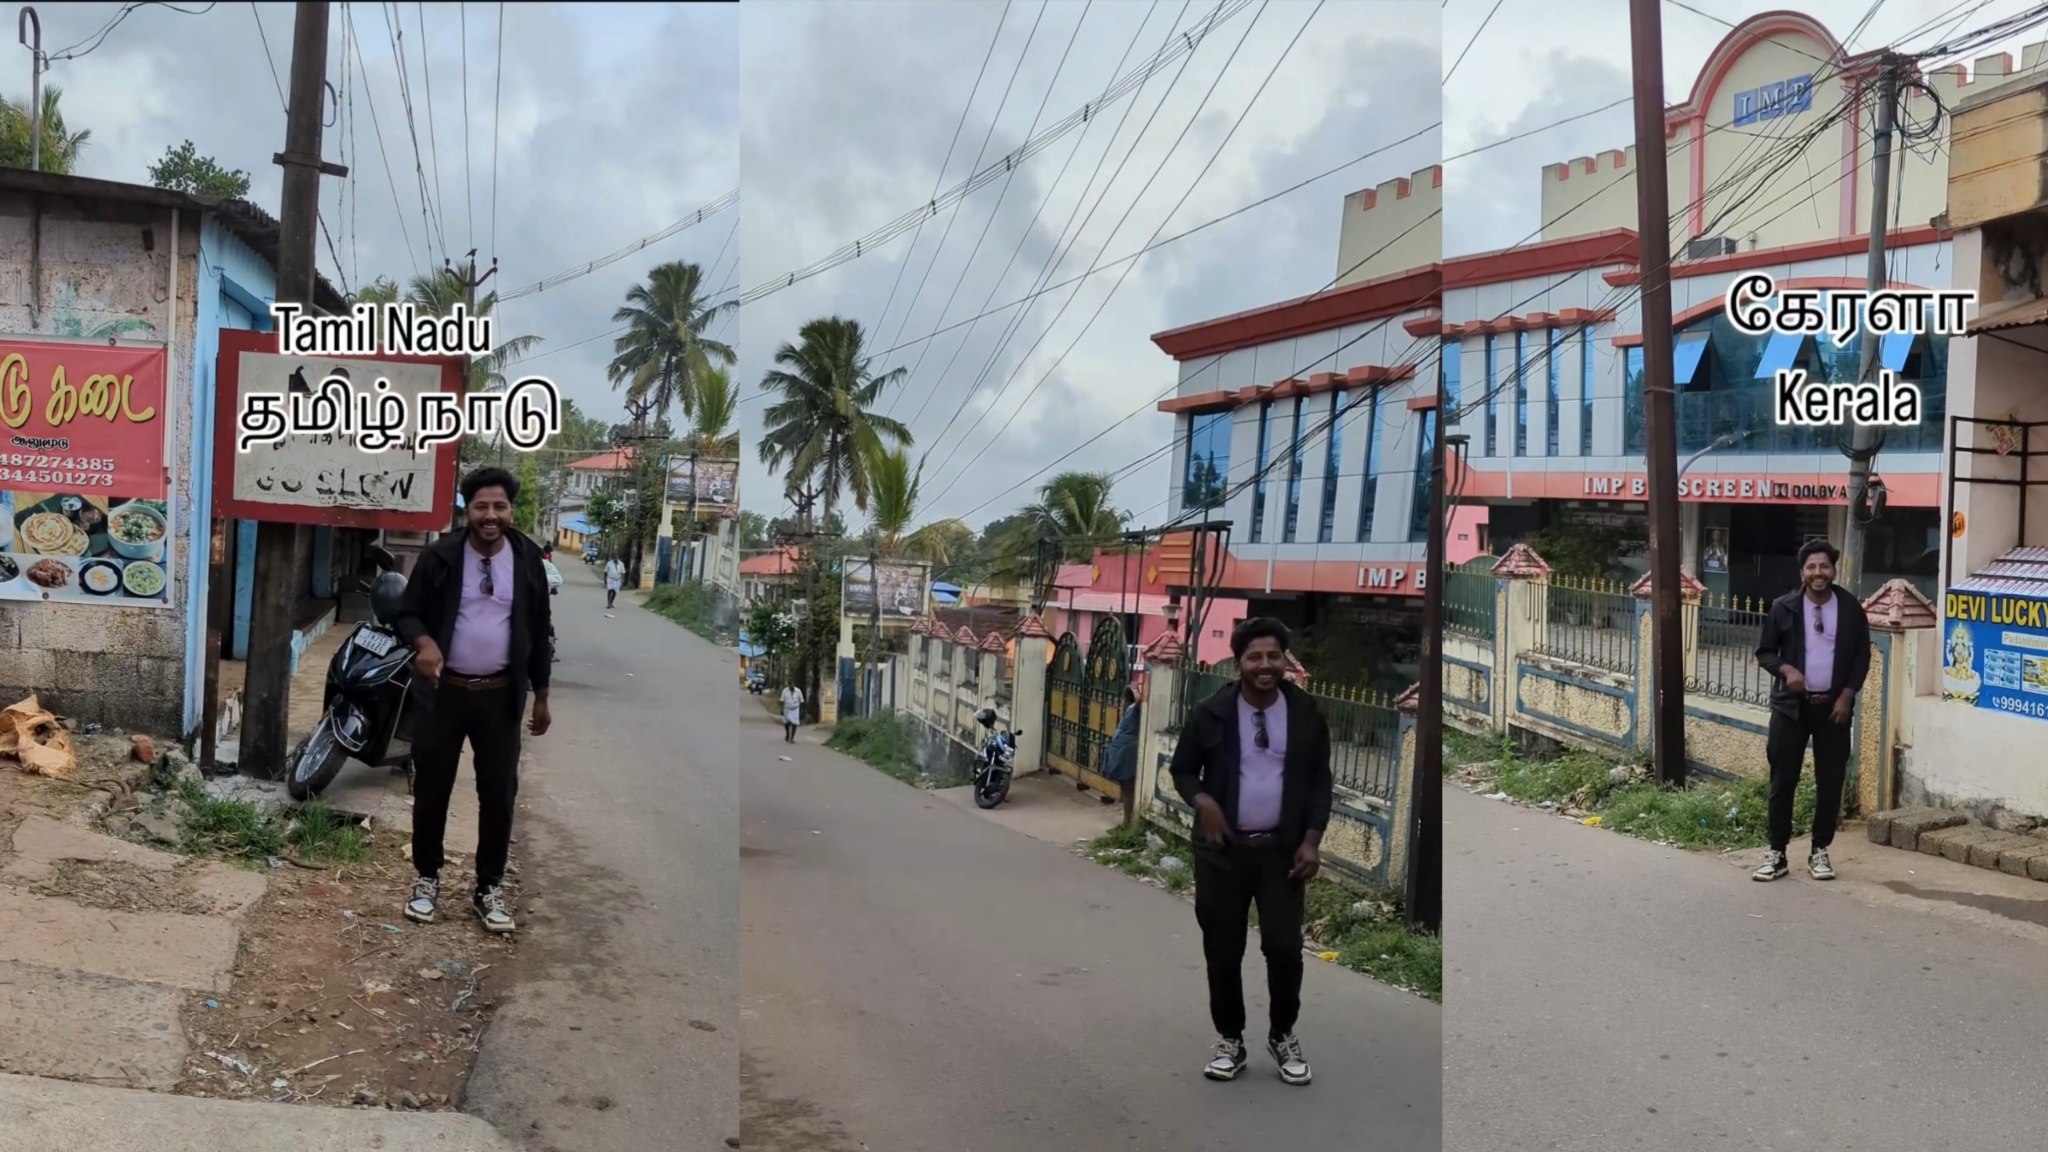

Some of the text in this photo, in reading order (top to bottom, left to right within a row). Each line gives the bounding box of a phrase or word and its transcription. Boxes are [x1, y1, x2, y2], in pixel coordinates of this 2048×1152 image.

[1741, 82, 1805, 117] IMP
[46, 365, 156, 426] கடை
[0, 468, 114, 487] 344501273
[316, 468, 415, 500] SLOW
[1585, 477, 1624, 494] IMP
[1678, 479, 1772, 498] SCREEN
[1793, 484, 1836, 499] DOLBY
[1358, 568, 1406, 588] IMP
[1946, 594, 1986, 622] DEVI
[2003, 633, 2048, 648] Padanthalu
